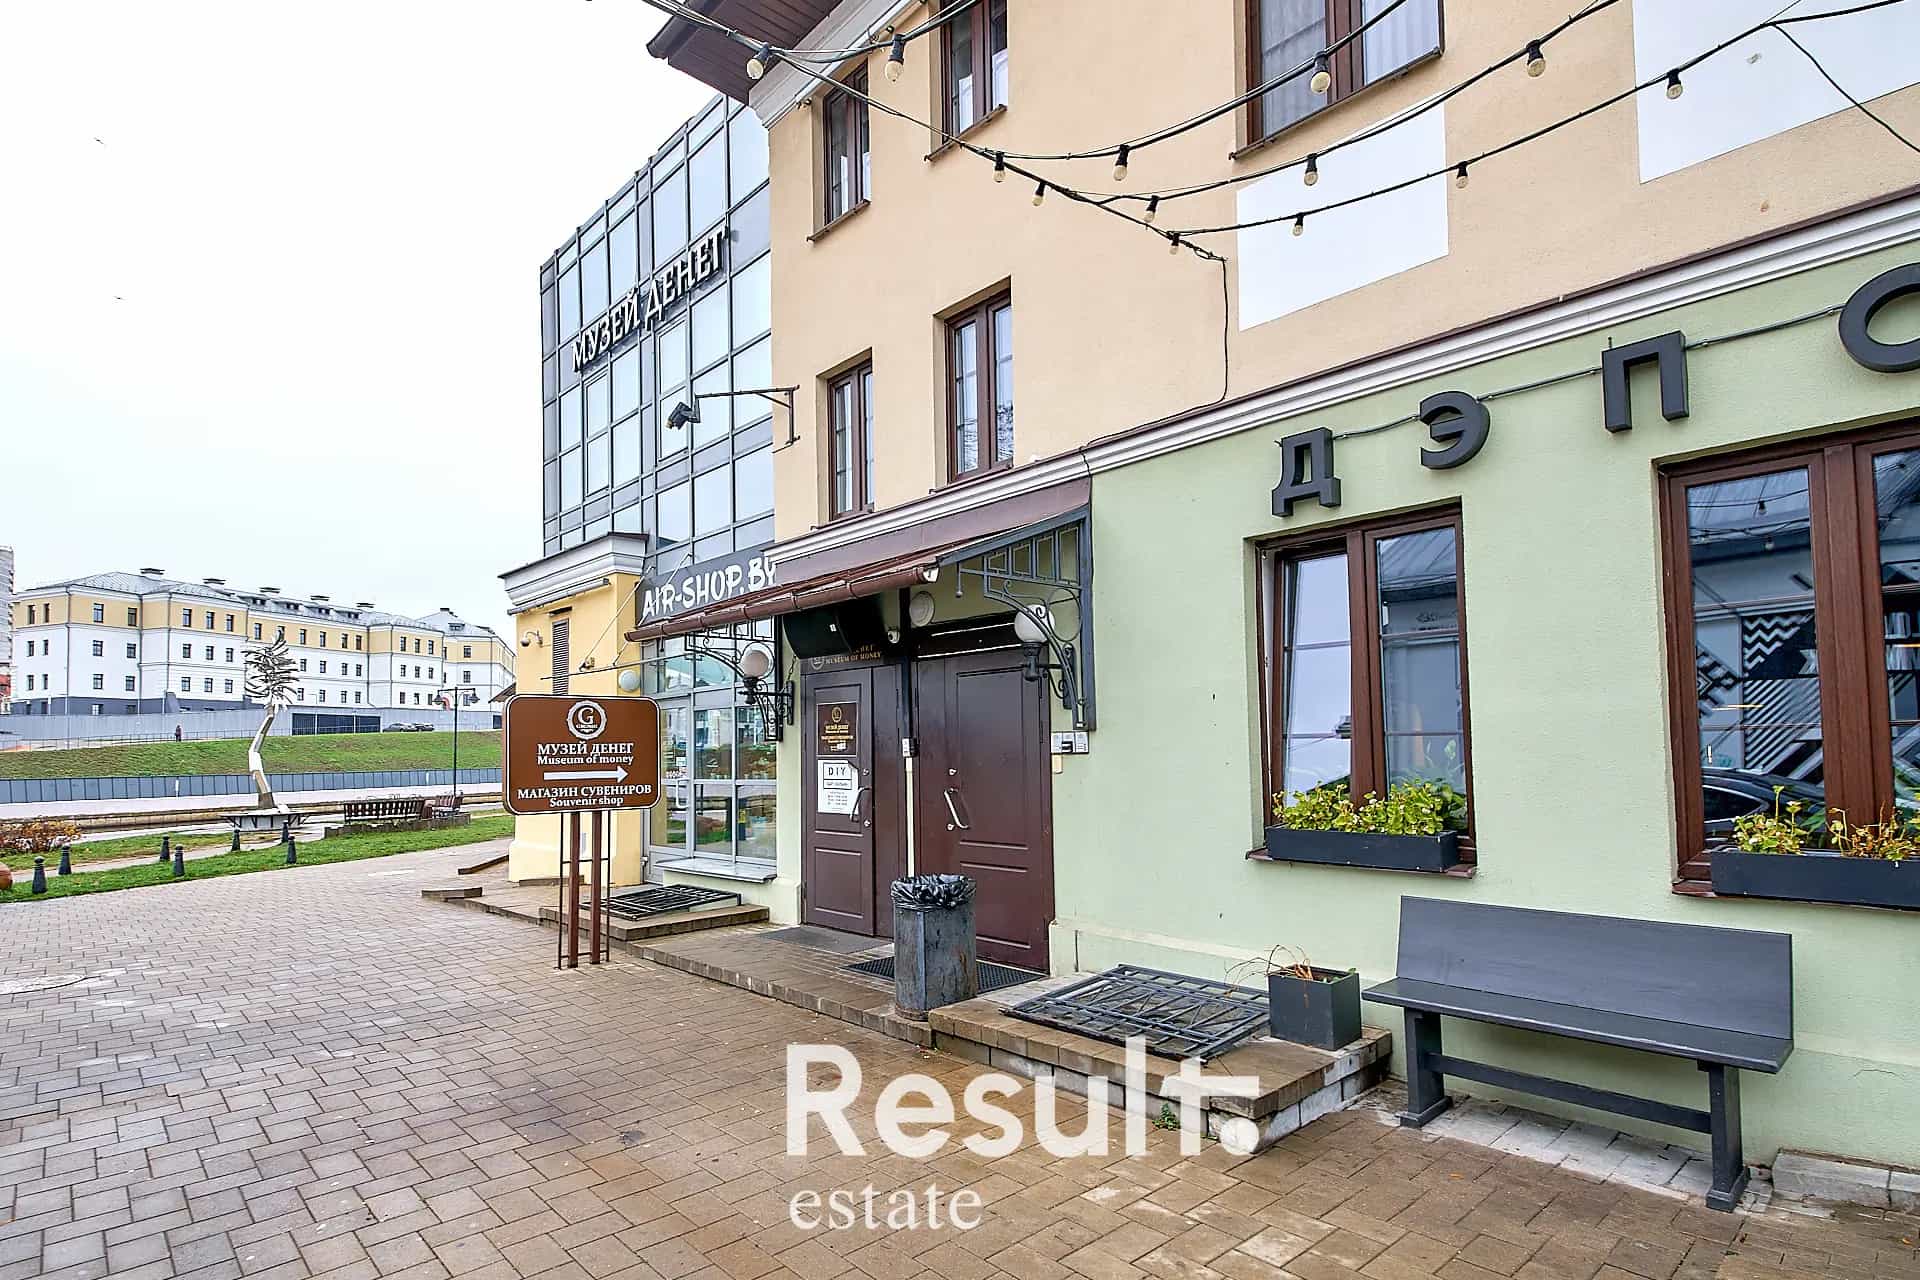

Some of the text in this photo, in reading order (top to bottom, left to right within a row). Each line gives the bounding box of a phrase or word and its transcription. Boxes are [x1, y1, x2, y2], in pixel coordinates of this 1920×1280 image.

[570, 226, 728, 373] МУЗЕЙ ДЕНЕГ
[537, 741, 634, 756] МУЗЕЙ ДЕНЕГ
[537, 755, 634, 765] Museum of money
[828, 767, 846, 776] DIY
[517, 784, 652, 799] МАГАЗИН СУВЕНИРОВ
[549, 796, 624, 807] Souvenir shop
